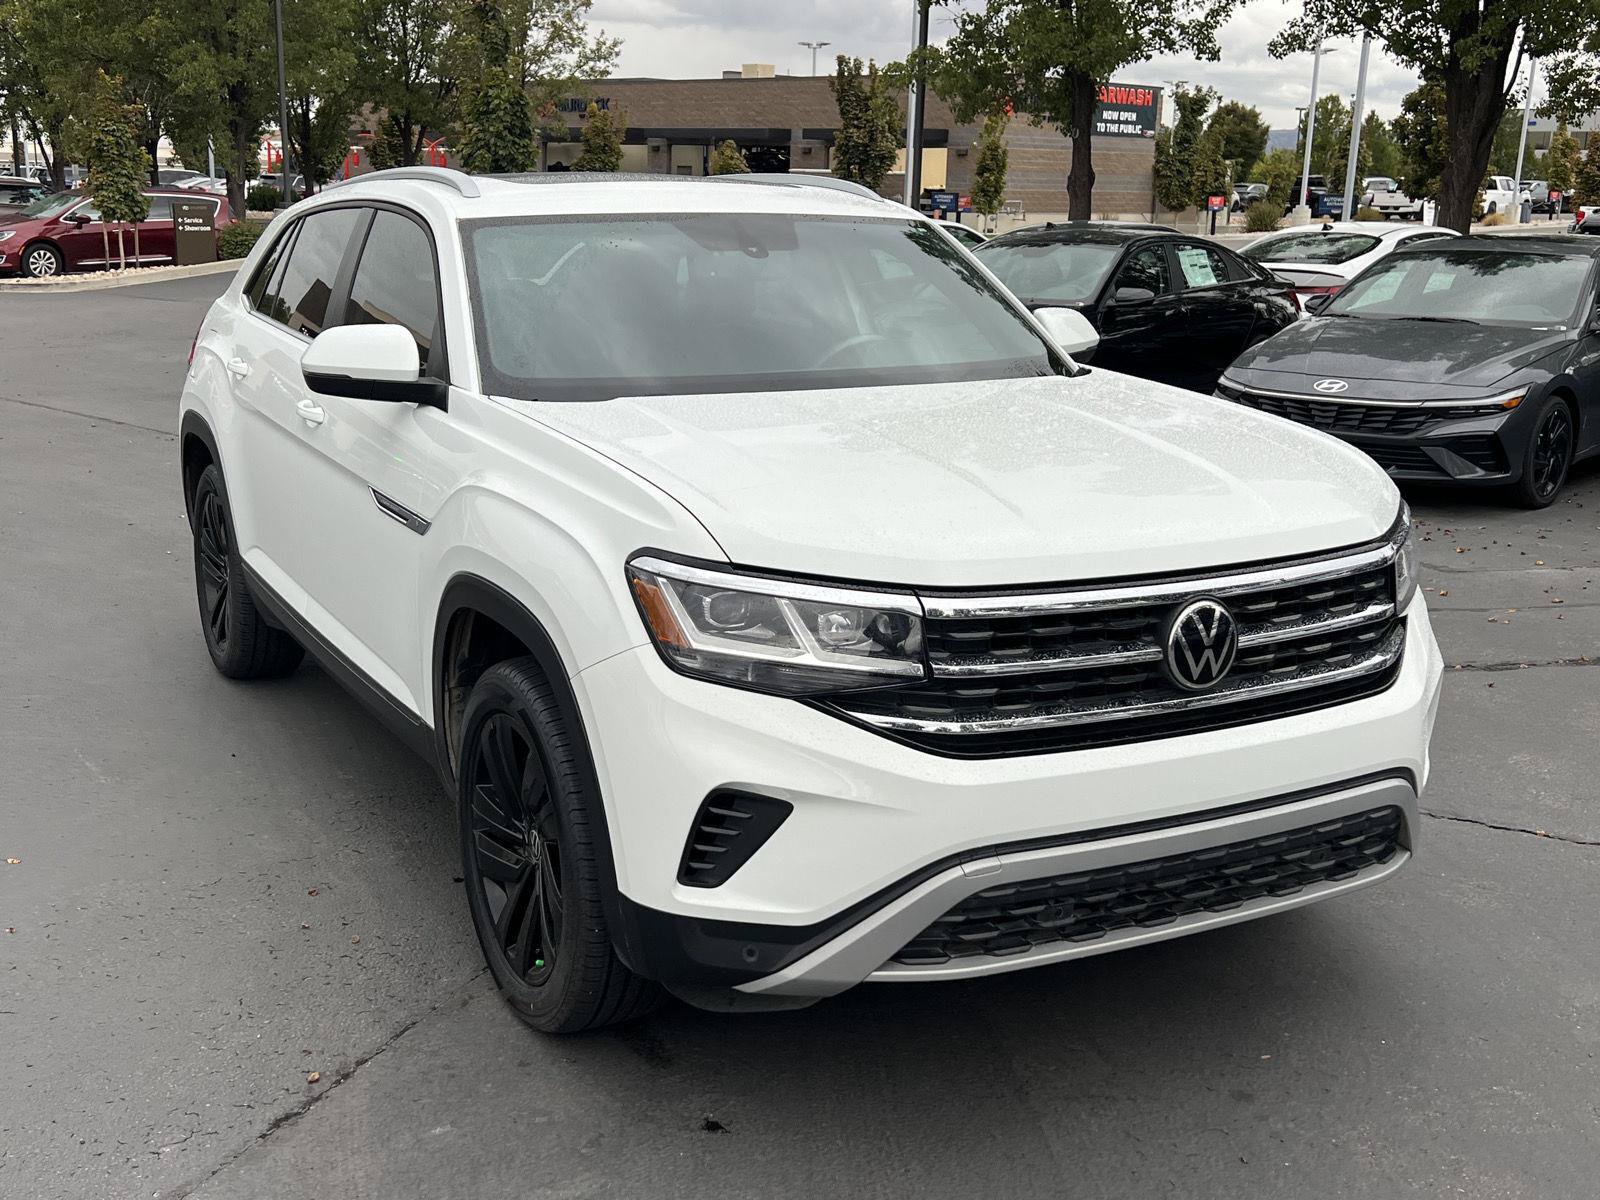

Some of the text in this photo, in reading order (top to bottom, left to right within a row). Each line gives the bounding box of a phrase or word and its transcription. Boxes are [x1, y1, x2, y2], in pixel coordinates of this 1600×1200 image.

[1097, 86, 1153, 106] ARWASH
[1102, 110, 1137, 121] NOW OPEN
[1096, 122, 1106, 132] TO
[1106, 123, 1119, 133] THE
[1119, 124, 1142, 134] PUBLIC
